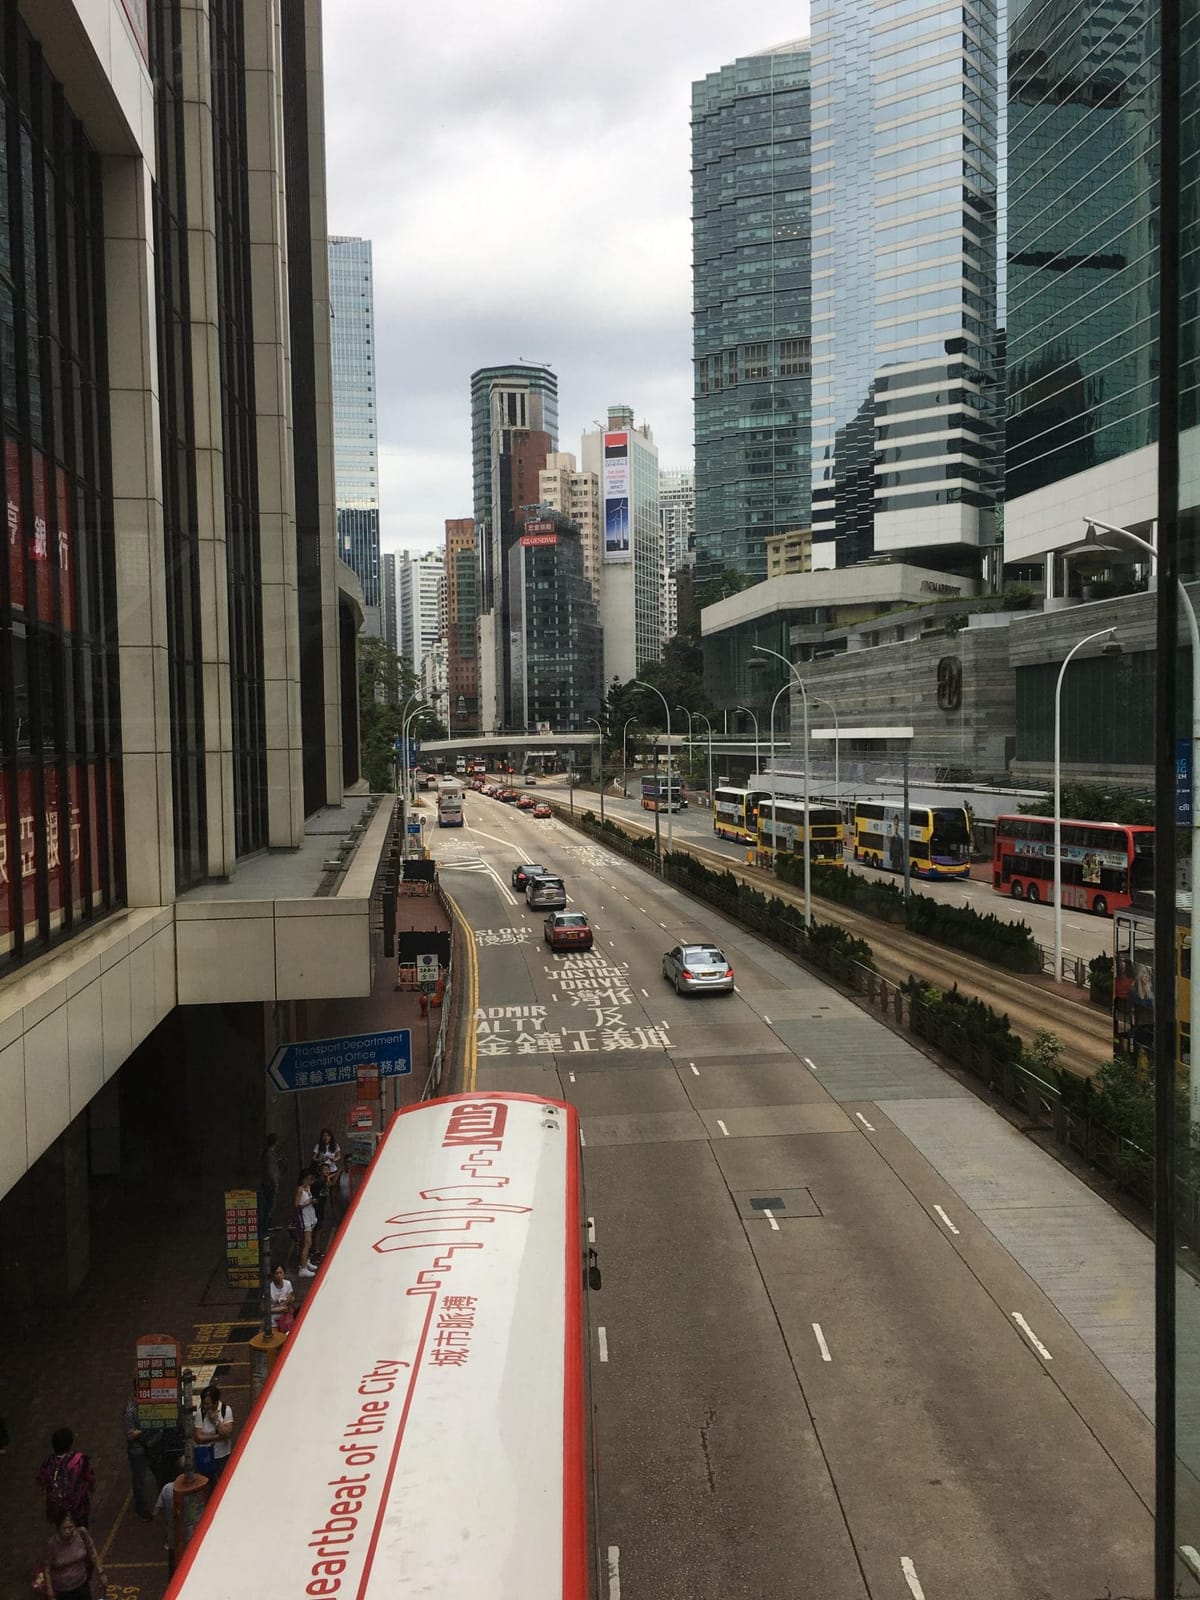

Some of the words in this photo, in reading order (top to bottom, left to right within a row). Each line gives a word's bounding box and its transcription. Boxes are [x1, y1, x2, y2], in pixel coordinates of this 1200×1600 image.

[474, 927, 527, 937] SLOW
[547, 967, 629, 979] JUSTICE
[563, 959, 609, 969] AND
[561, 977, 632, 990] DRIVE
[568, 988, 632, 1006] 灣仔
[473, 1005, 548, 1019] ADMIR
[587, 1006, 627, 1026] 及
[476, 1018, 545, 1034] ALTY
[295, 1043, 341, 1057] Transport
[343, 1034, 403, 1050] Department
[476, 1032, 565, 1056] 金鐘
[565, 1026, 677, 1053] 正義道
[294, 1054, 343, 1069] Licensing
[345, 1050, 376, 1062] Office
[441, 1102, 508, 1147] KMB
[428, 1295, 478, 1367] 城市脈搏
[358, 1360, 411, 1396] City
[139, 1390, 150, 1399] 104
[343, 1400, 390, 1437] the
[339, 1443, 378, 1466] of
[305, 1473, 371, 1600] eartbeat
